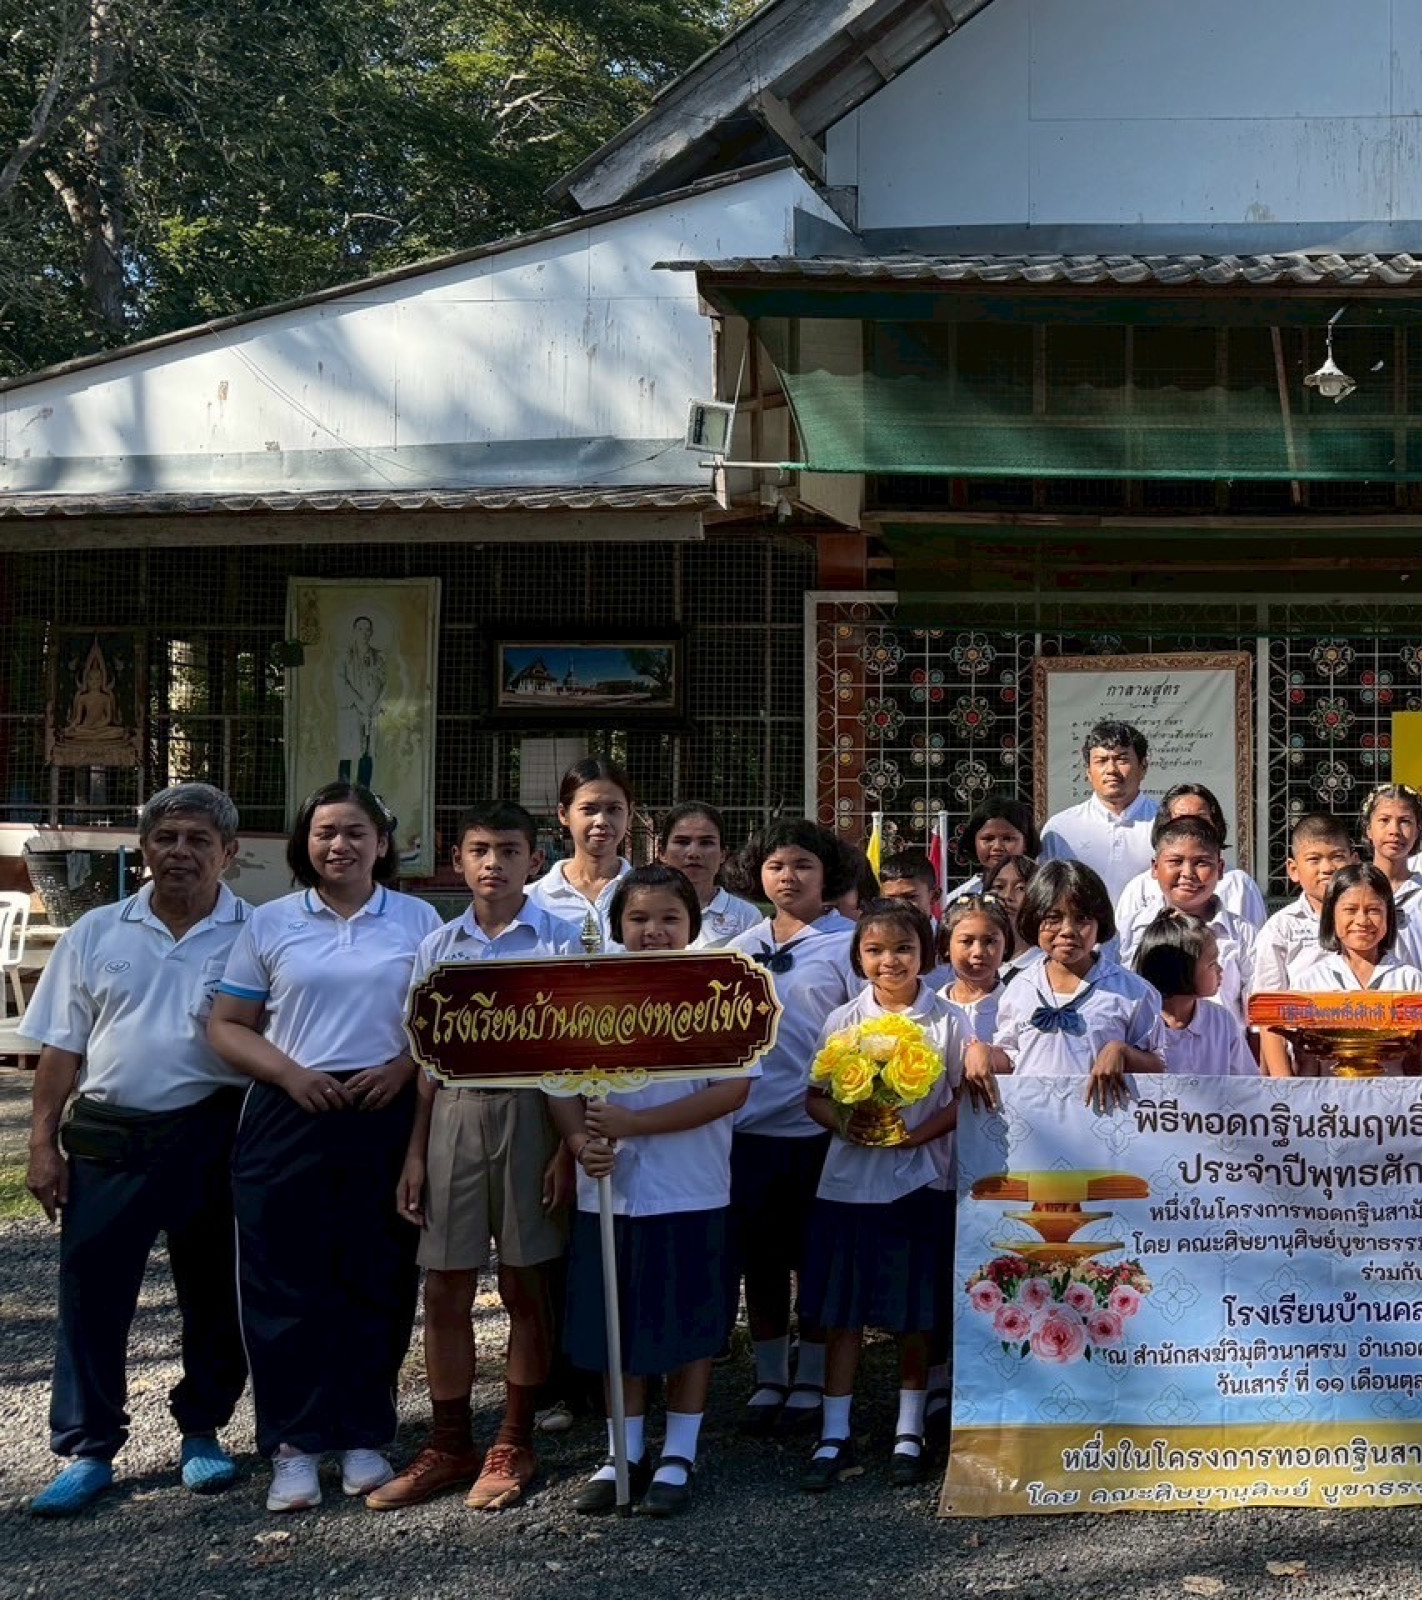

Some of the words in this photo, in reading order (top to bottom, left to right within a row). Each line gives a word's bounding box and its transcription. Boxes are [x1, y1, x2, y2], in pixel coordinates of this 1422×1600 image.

[430, 979, 753, 1046] โรงเรียนบ้านคลองหอยโข่ง
[1132, 1231, 1171, 1254] โดย
[1108, 1348, 1127, 1365] ณ
[1133, 1336, 1347, 1369] สำนักสงฆ์วิมุติวนาศรม
[1217, 1369, 1289, 1396] วันเสาร์
[1294, 1363, 1310, 1392] ที่
[1316, 1377, 1345, 1393] ๑๑
[1026, 1481, 1079, 1506] โดย
[1090, 1479, 1311, 1506] คณะศิษยานุศิษย์
